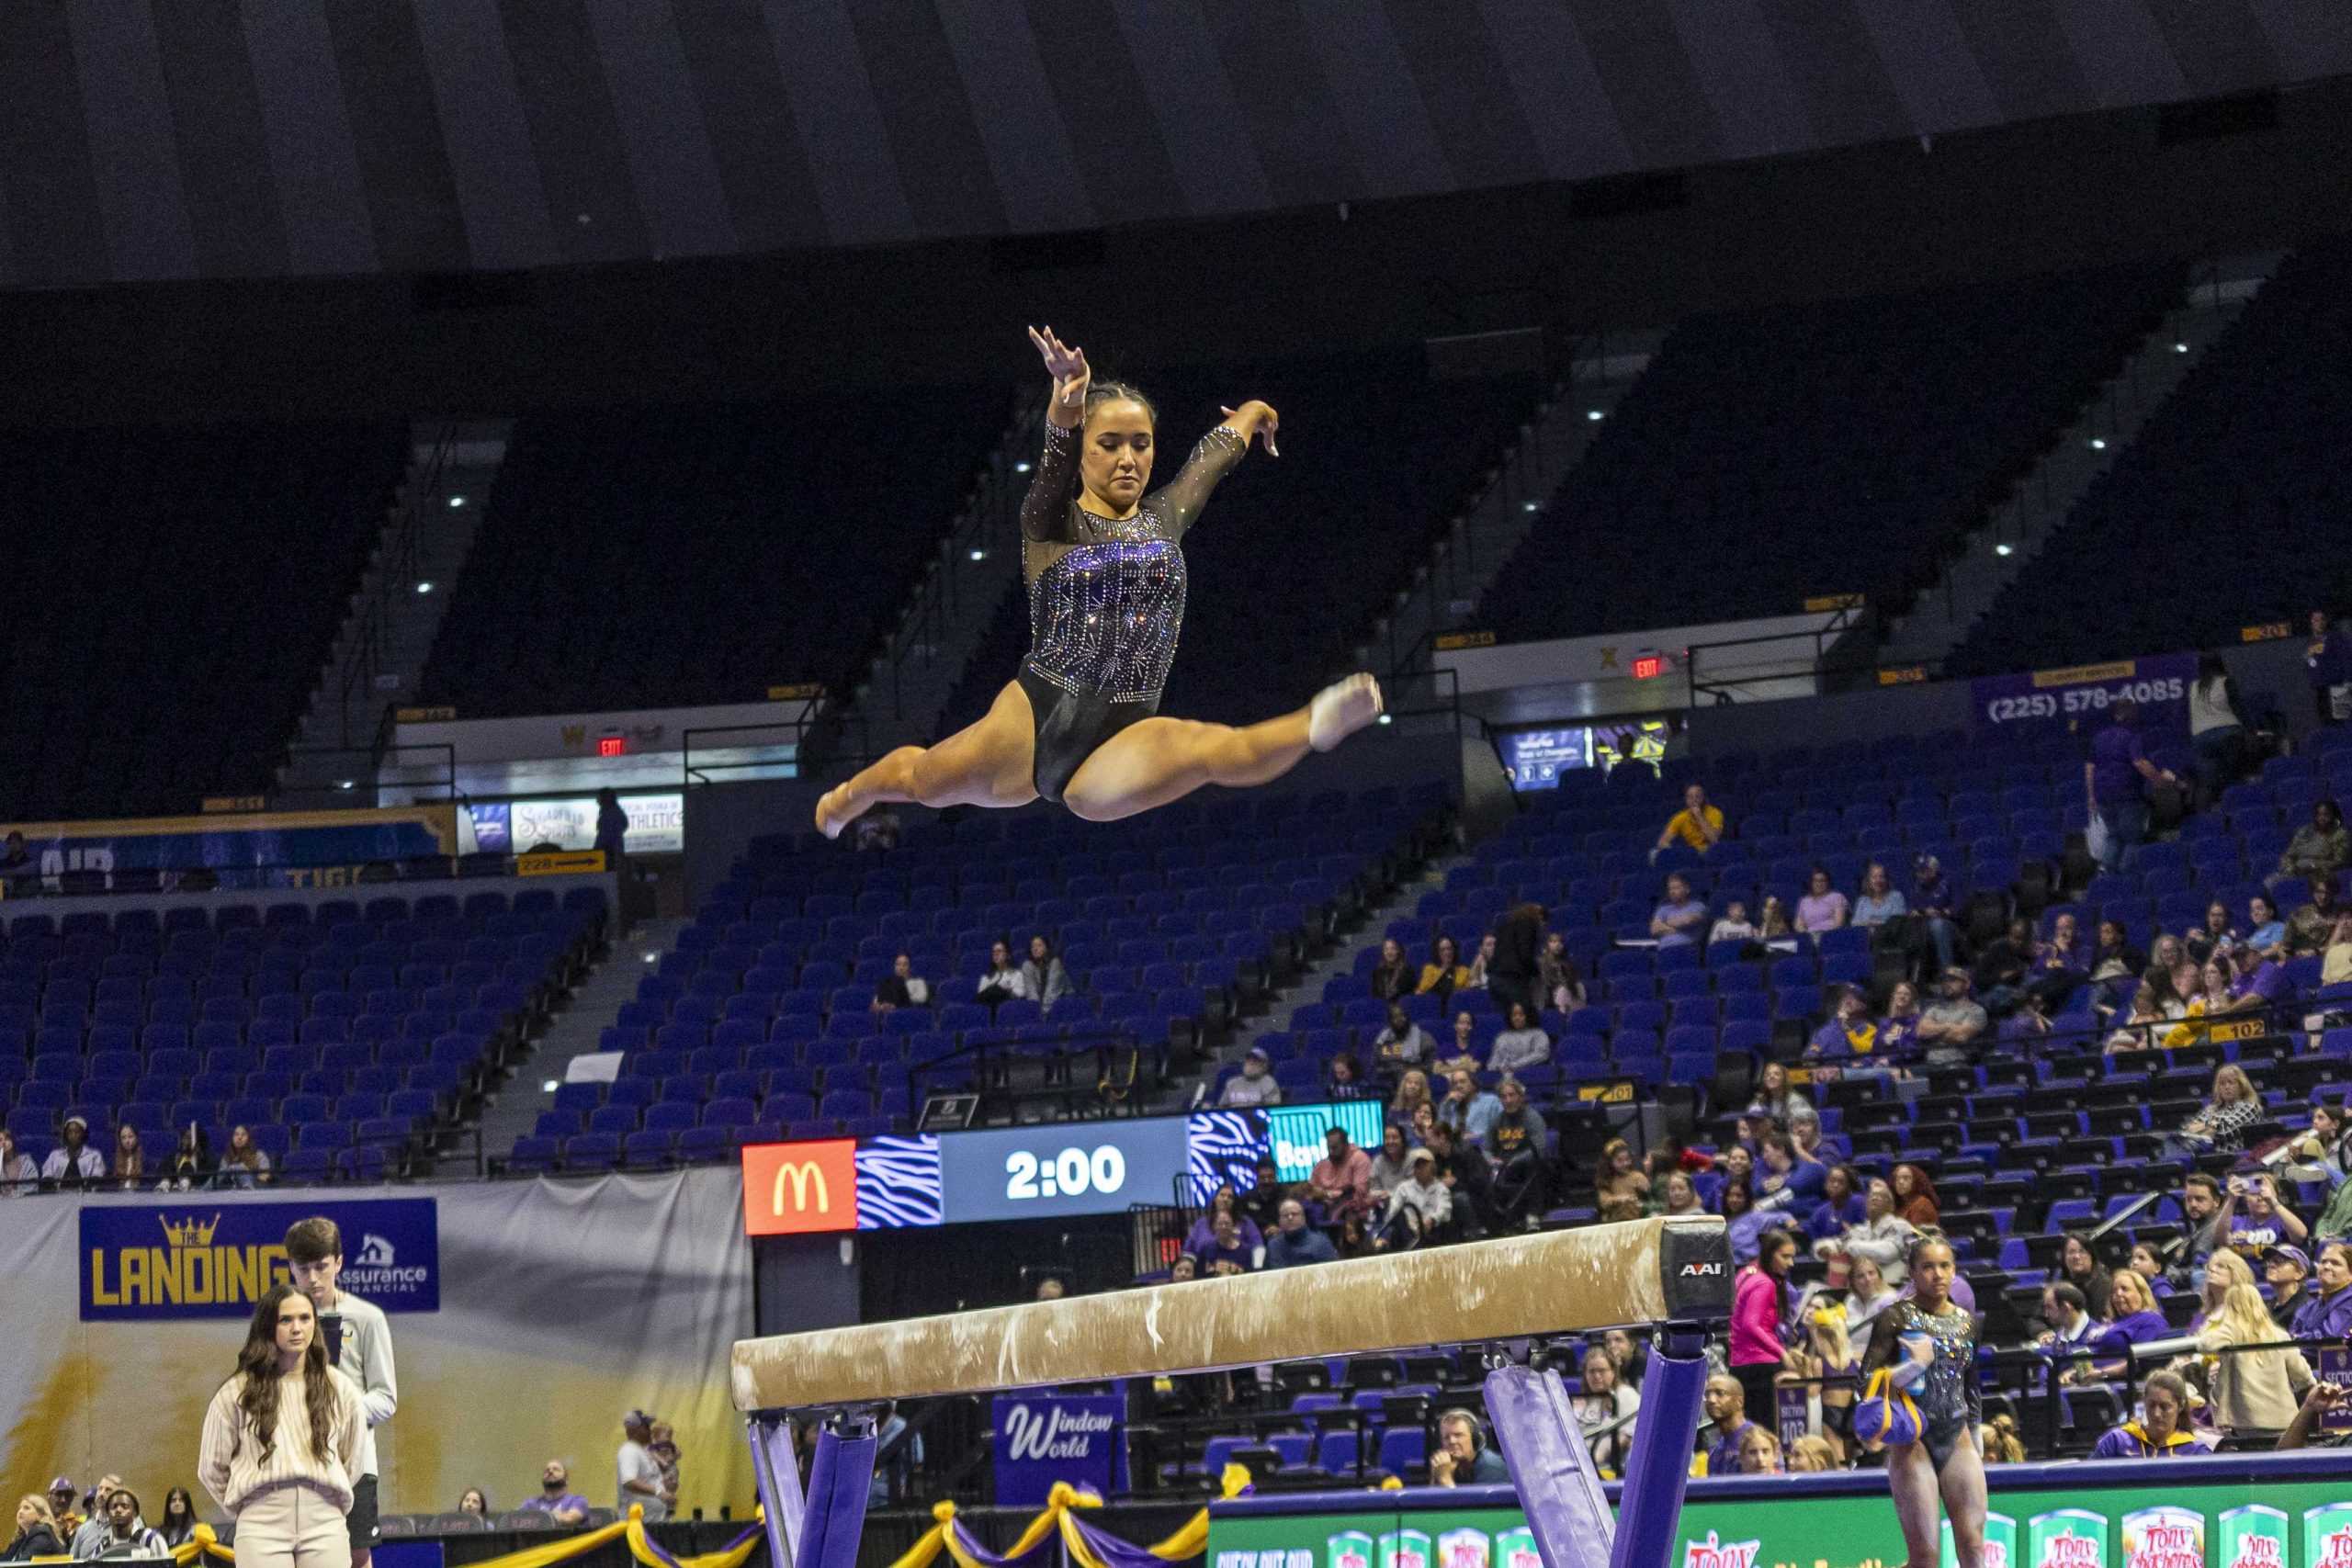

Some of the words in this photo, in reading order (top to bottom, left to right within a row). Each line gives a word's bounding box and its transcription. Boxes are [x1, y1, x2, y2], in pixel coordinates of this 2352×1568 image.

[1636, 660, 1657, 678] EXIT
[1988, 694, 2058, 724] (225)
[2063, 678, 2184, 713] 578-4085
[602, 739, 622, 758] EXIT
[2231, 1021, 2264, 1038] 102
[1006, 1145, 1125, 1199] 2:00
[337, 1267, 426, 1284] ssurance
[1005, 1404, 1113, 1461] Window
